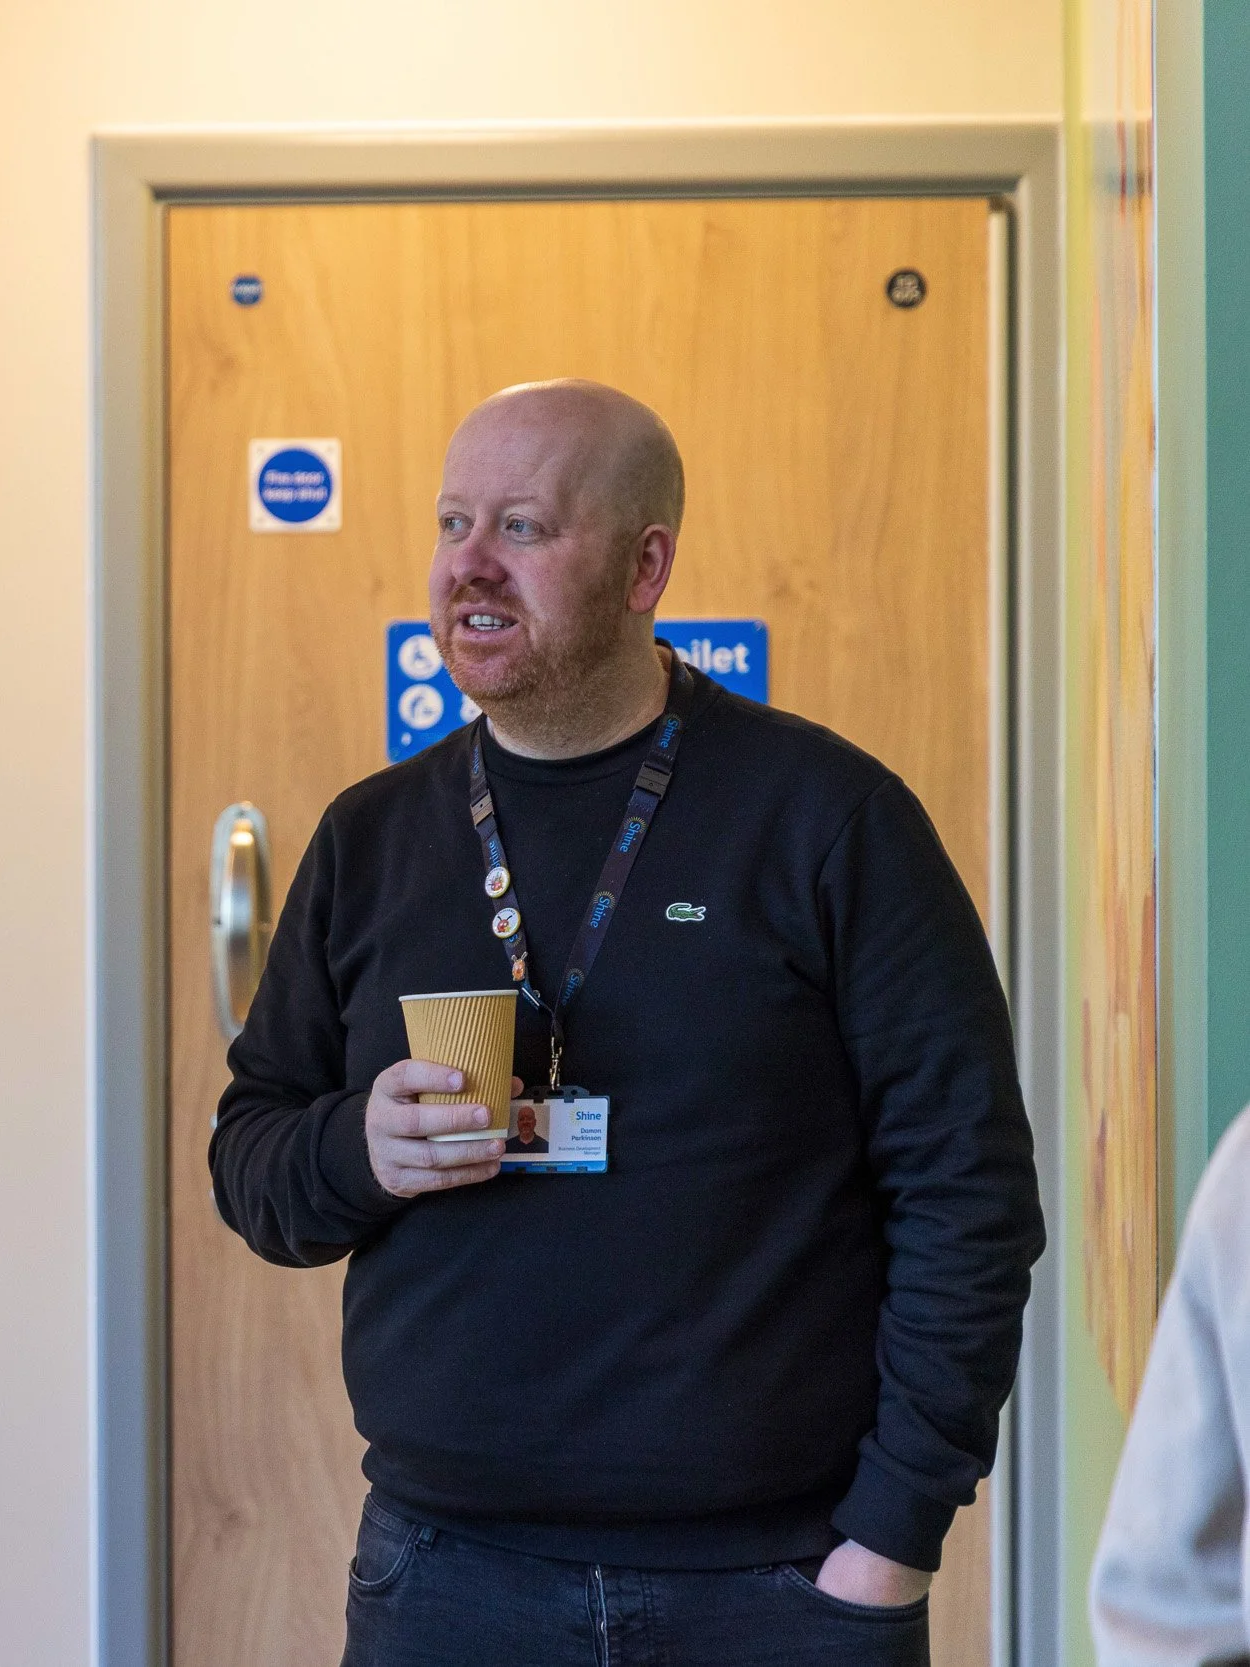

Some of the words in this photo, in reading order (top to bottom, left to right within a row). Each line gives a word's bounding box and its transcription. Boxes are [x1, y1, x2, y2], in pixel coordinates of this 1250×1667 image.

[674, 638, 749, 674] ilet
[660, 719, 679, 748] Shine
[620, 822, 641, 853] Shine
[590, 896, 610, 928] Shine
[576, 1111, 601, 1120] Shine
